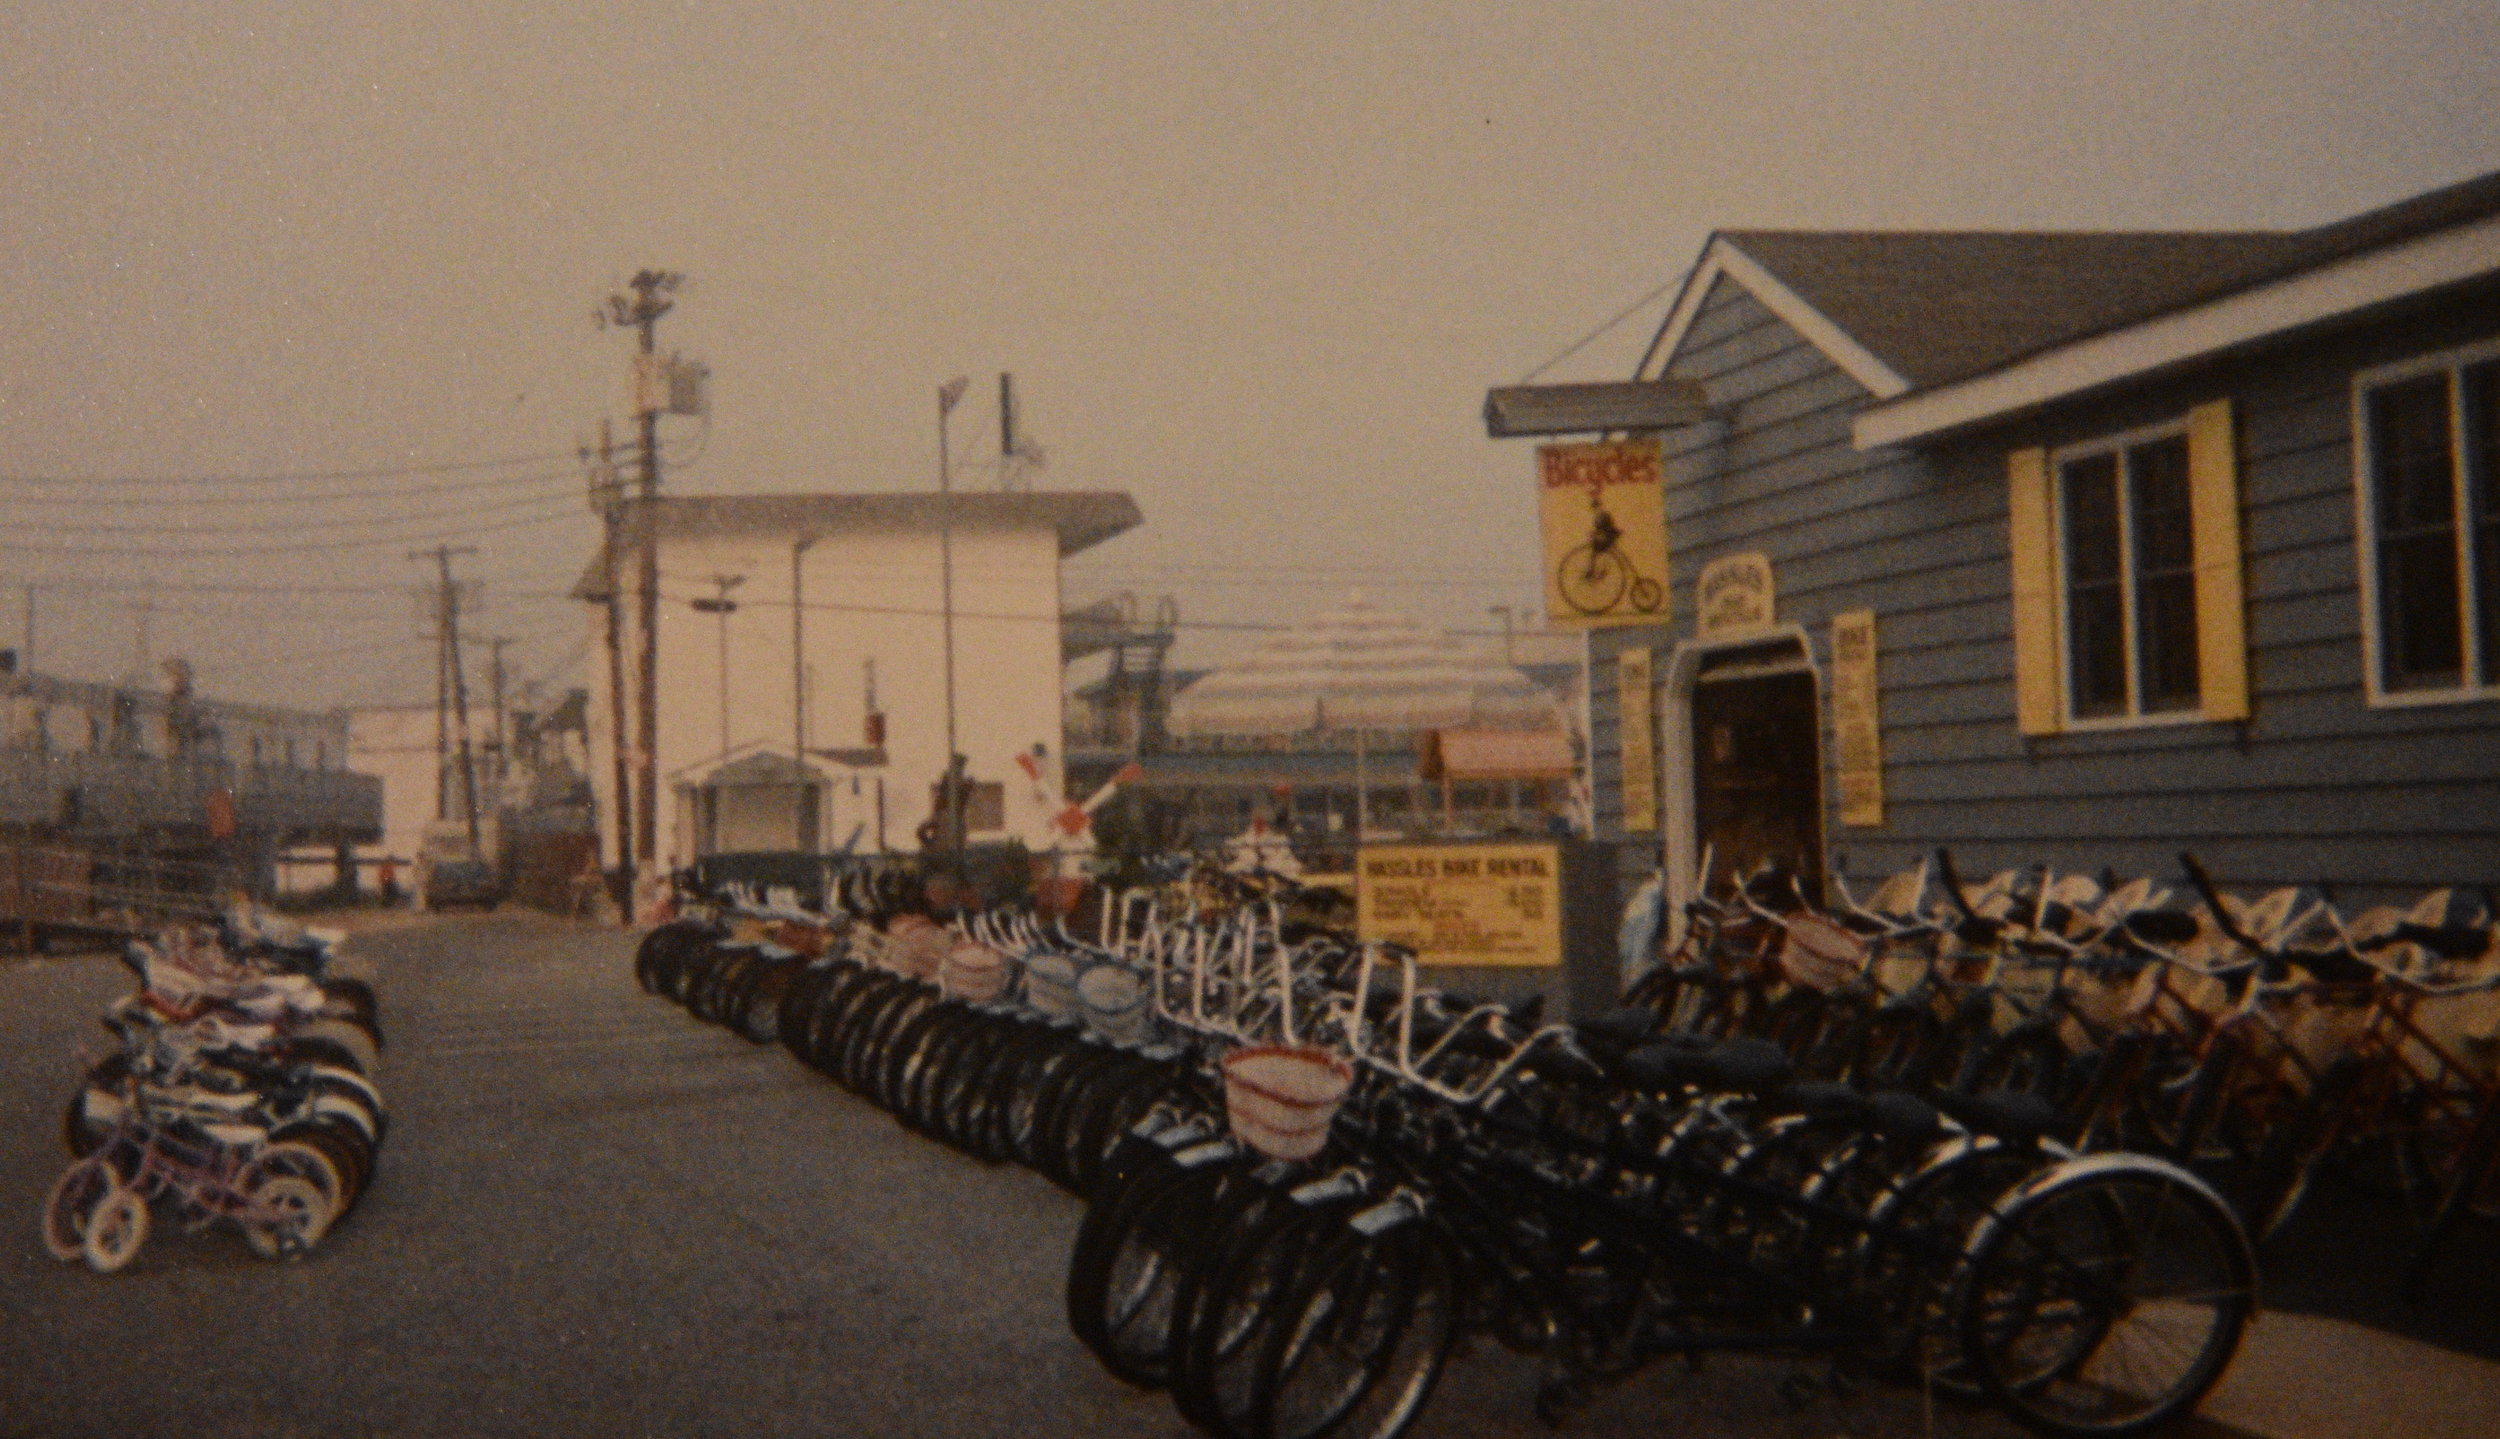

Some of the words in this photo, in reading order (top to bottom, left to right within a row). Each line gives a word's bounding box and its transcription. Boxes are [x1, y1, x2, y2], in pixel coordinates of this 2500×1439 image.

[1543, 443, 1657, 497] Bicycles
[1443, 858, 1481, 877] BIKE
[1487, 857, 1550, 877] RENTAL
